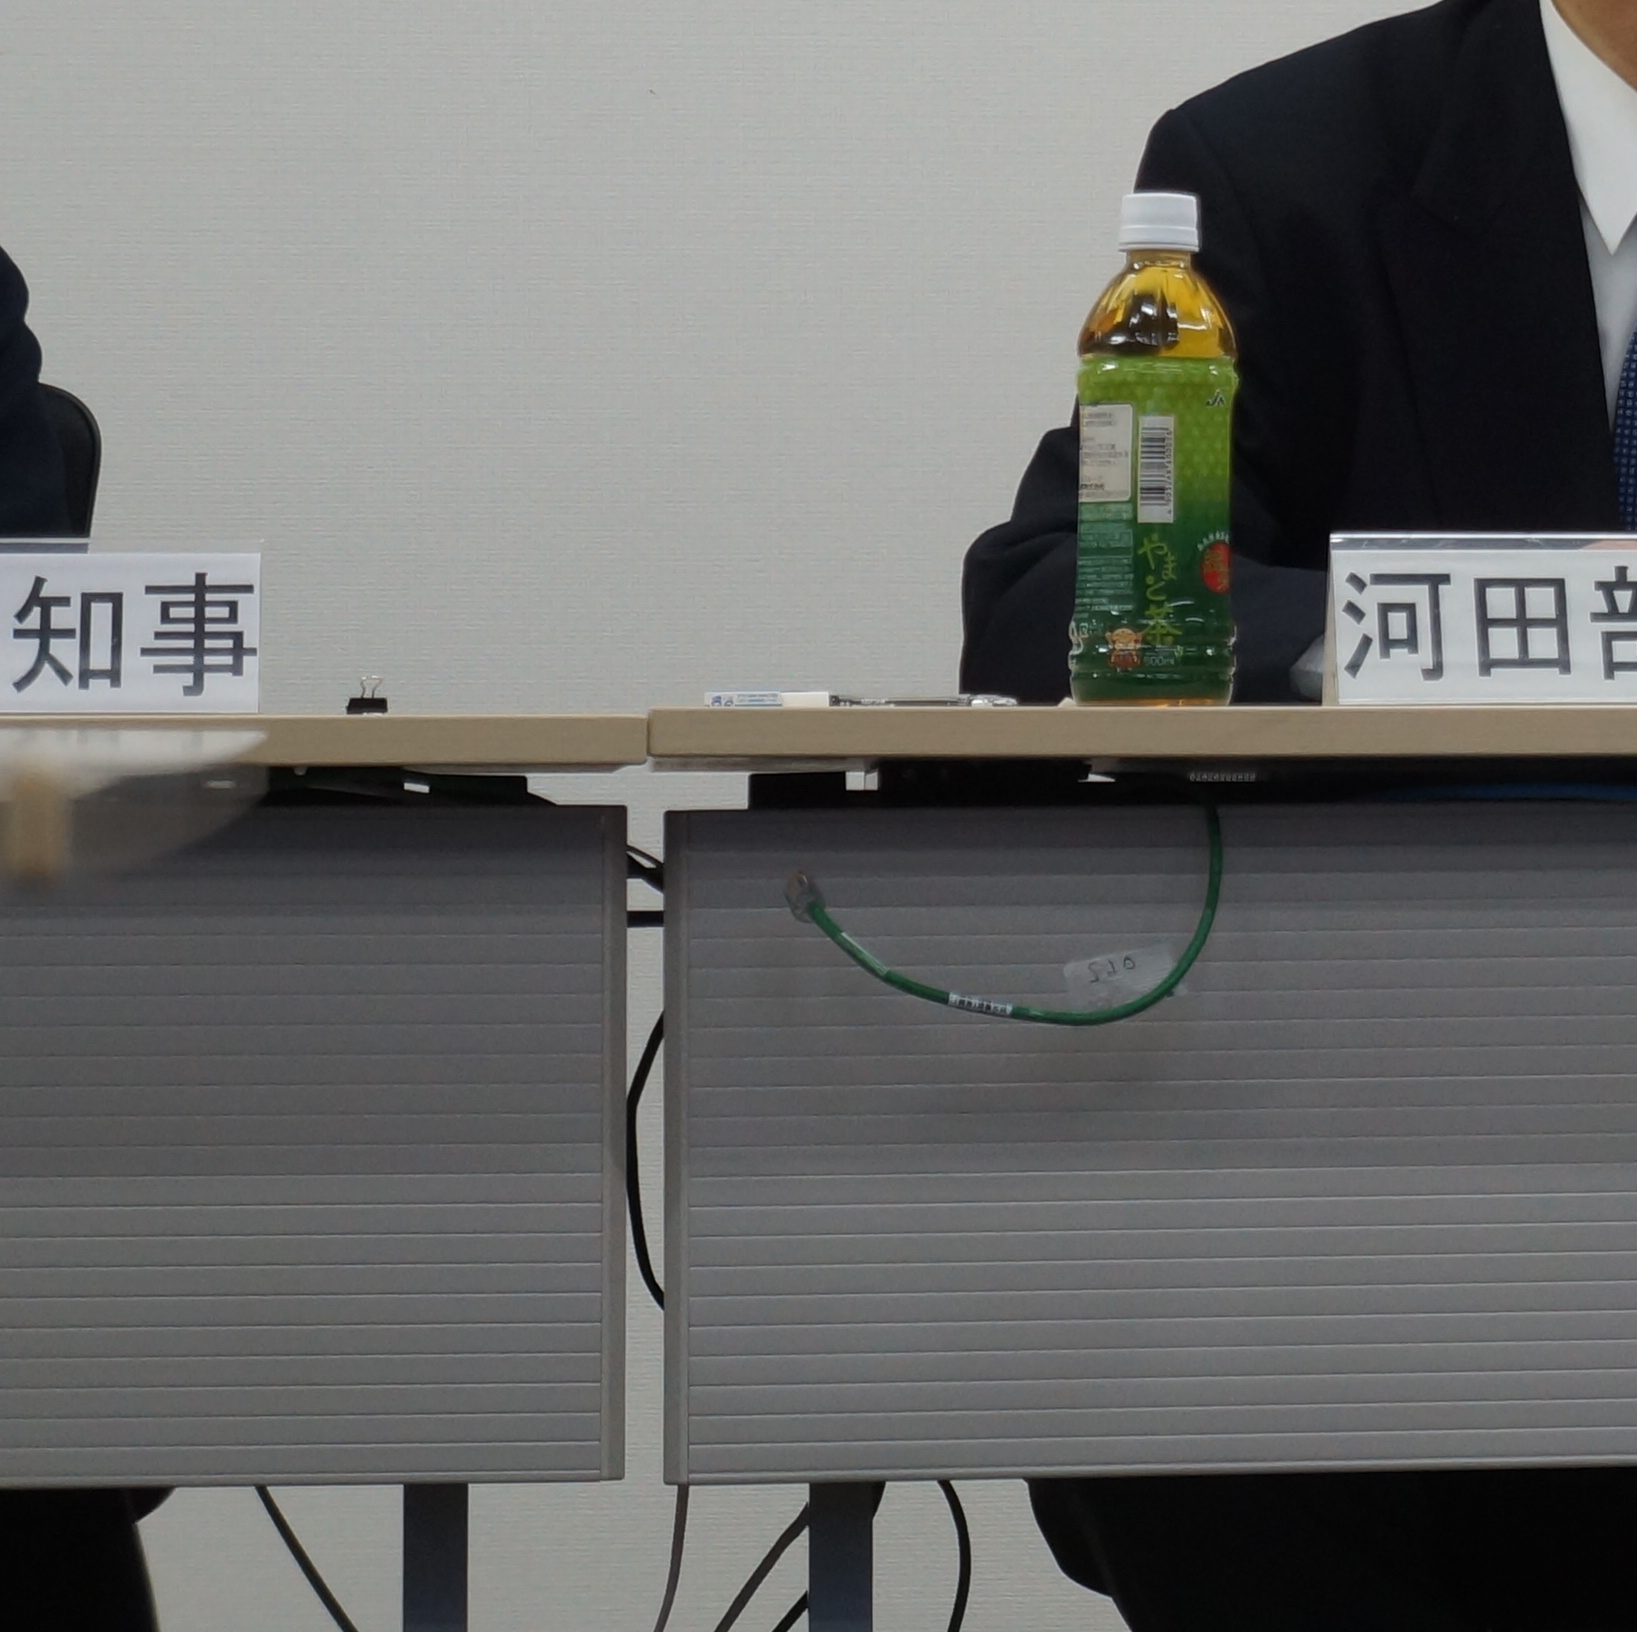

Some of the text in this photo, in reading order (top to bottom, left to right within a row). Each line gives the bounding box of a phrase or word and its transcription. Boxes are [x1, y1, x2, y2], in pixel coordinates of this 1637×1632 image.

[12, 572, 258, 697] 知事
[1137, 533, 1184, 645] やまと茶
